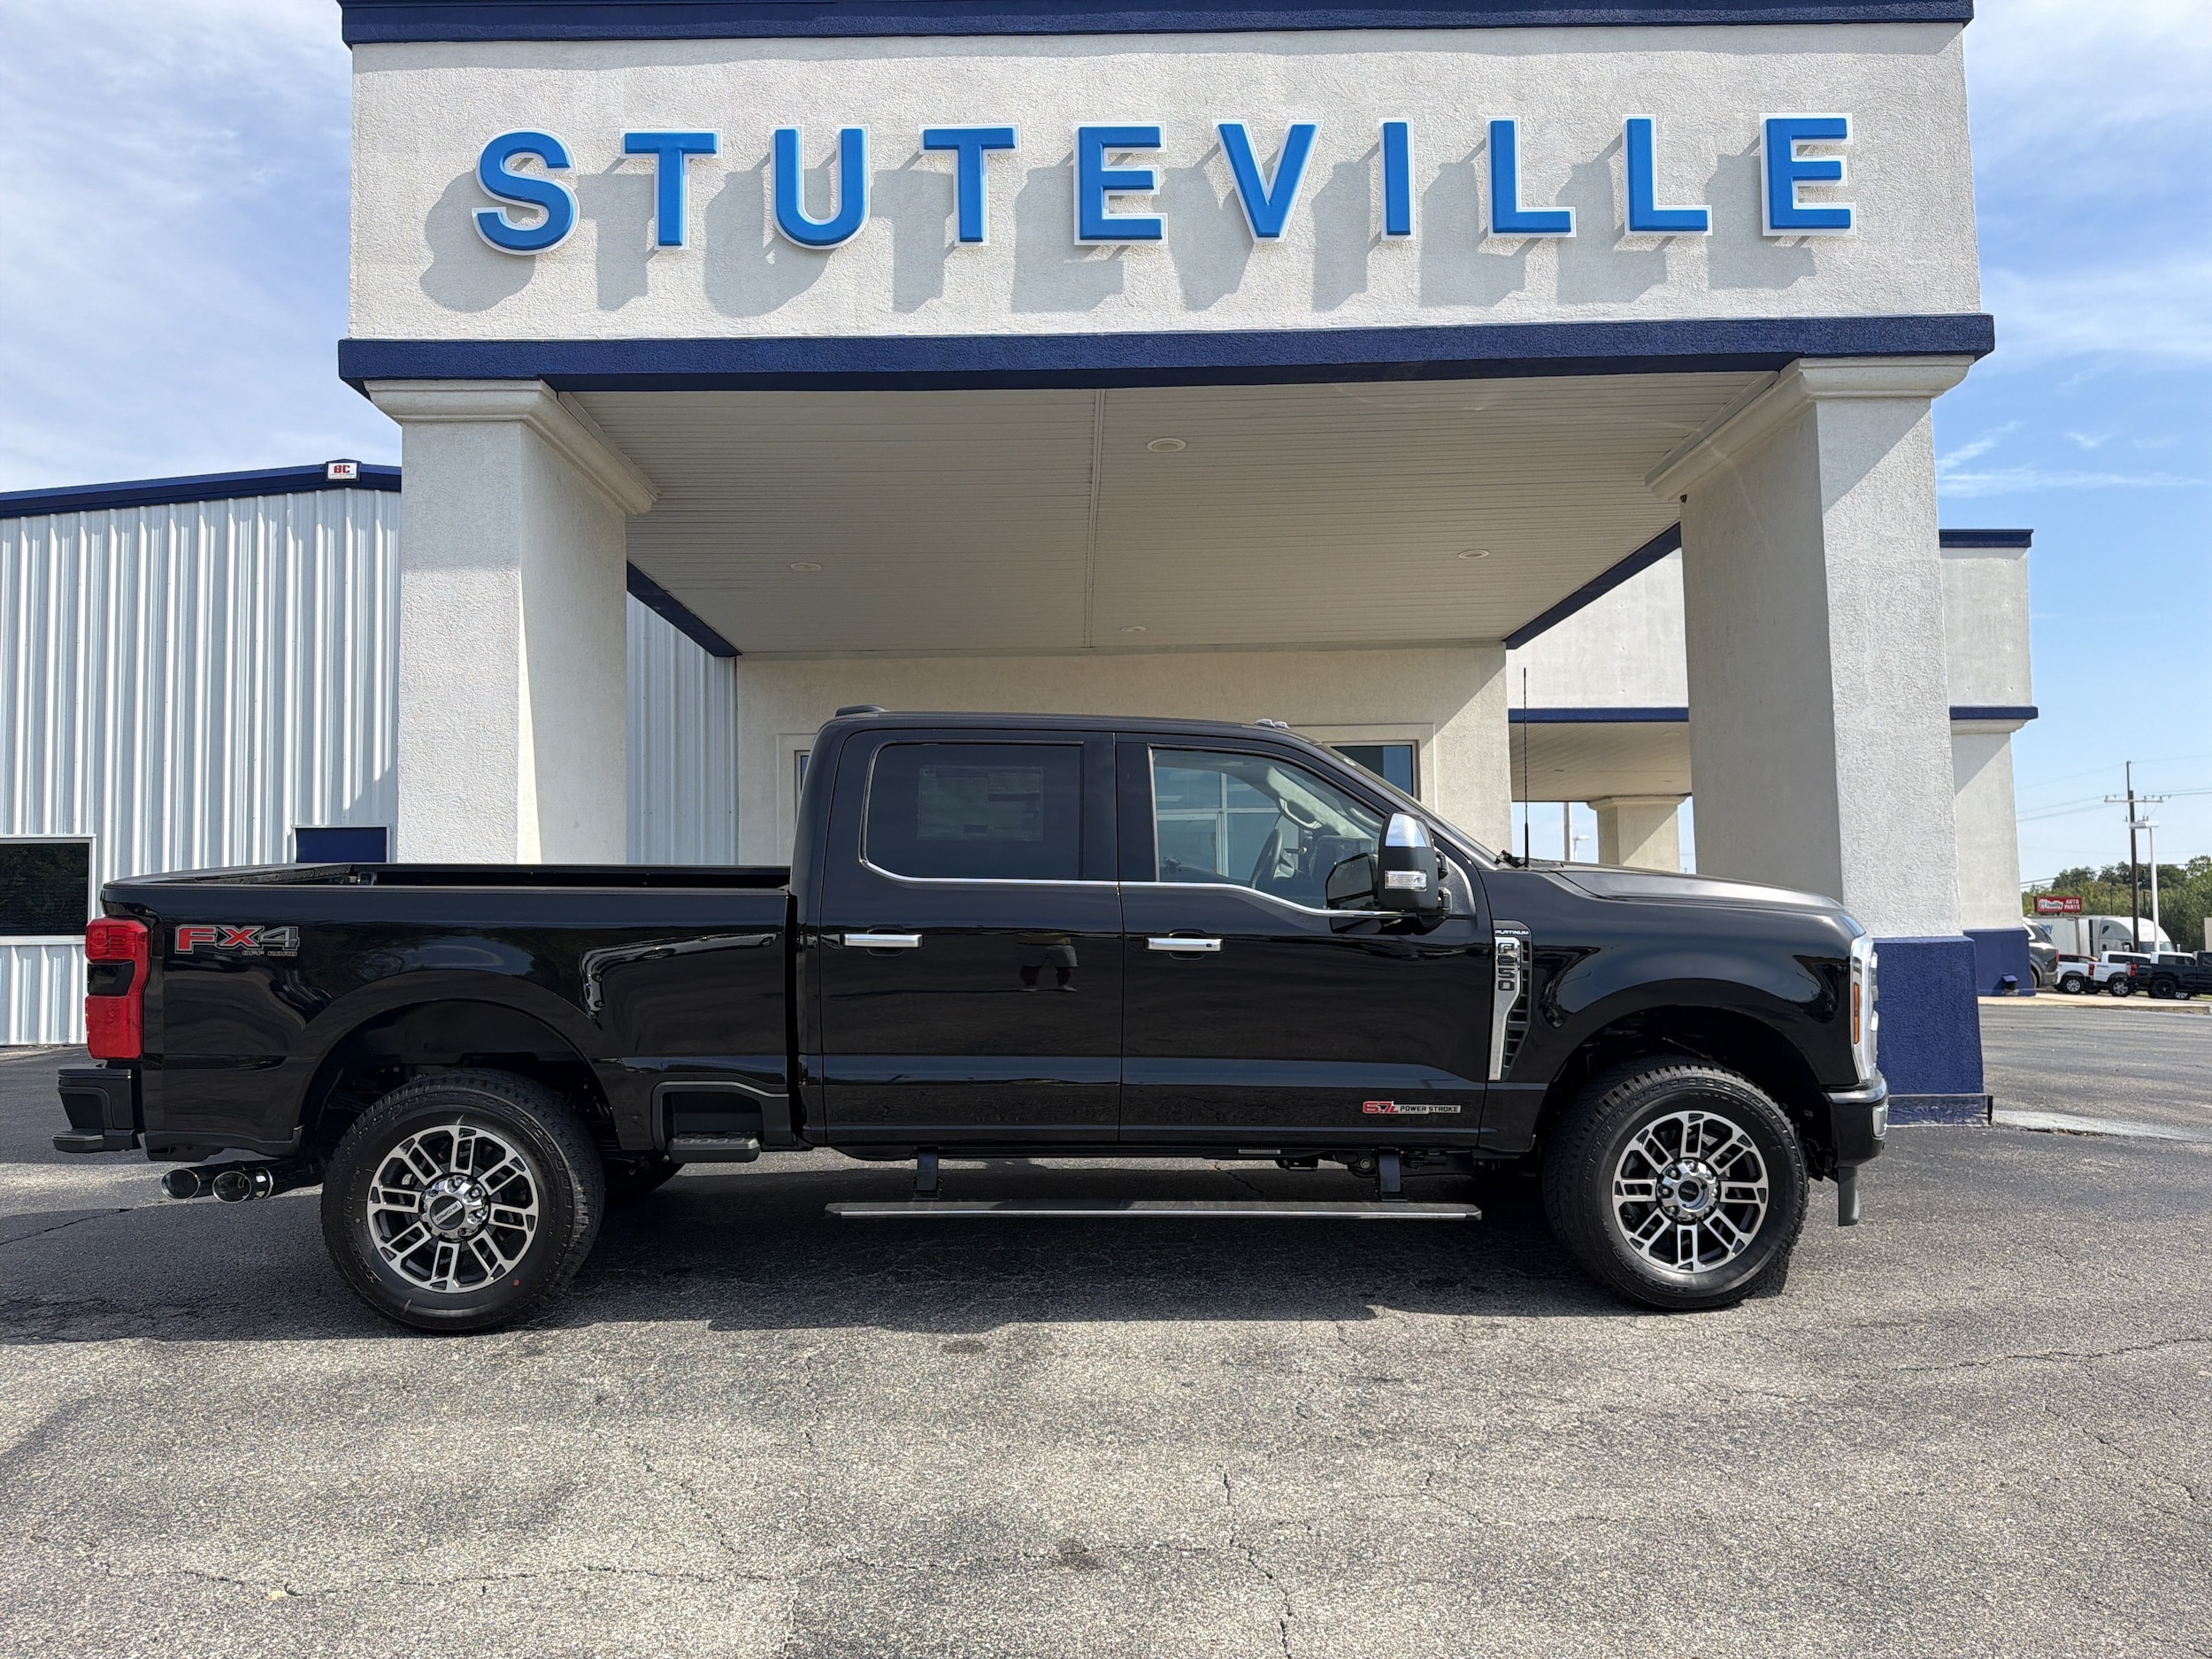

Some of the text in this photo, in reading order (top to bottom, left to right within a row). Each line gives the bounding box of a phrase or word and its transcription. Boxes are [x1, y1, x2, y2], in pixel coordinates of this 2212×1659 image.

[474, 114, 1855, 254] STUTEVILLE
[174, 924, 301, 954] FX4
[1363, 1101, 1399, 1115] 6.7L
